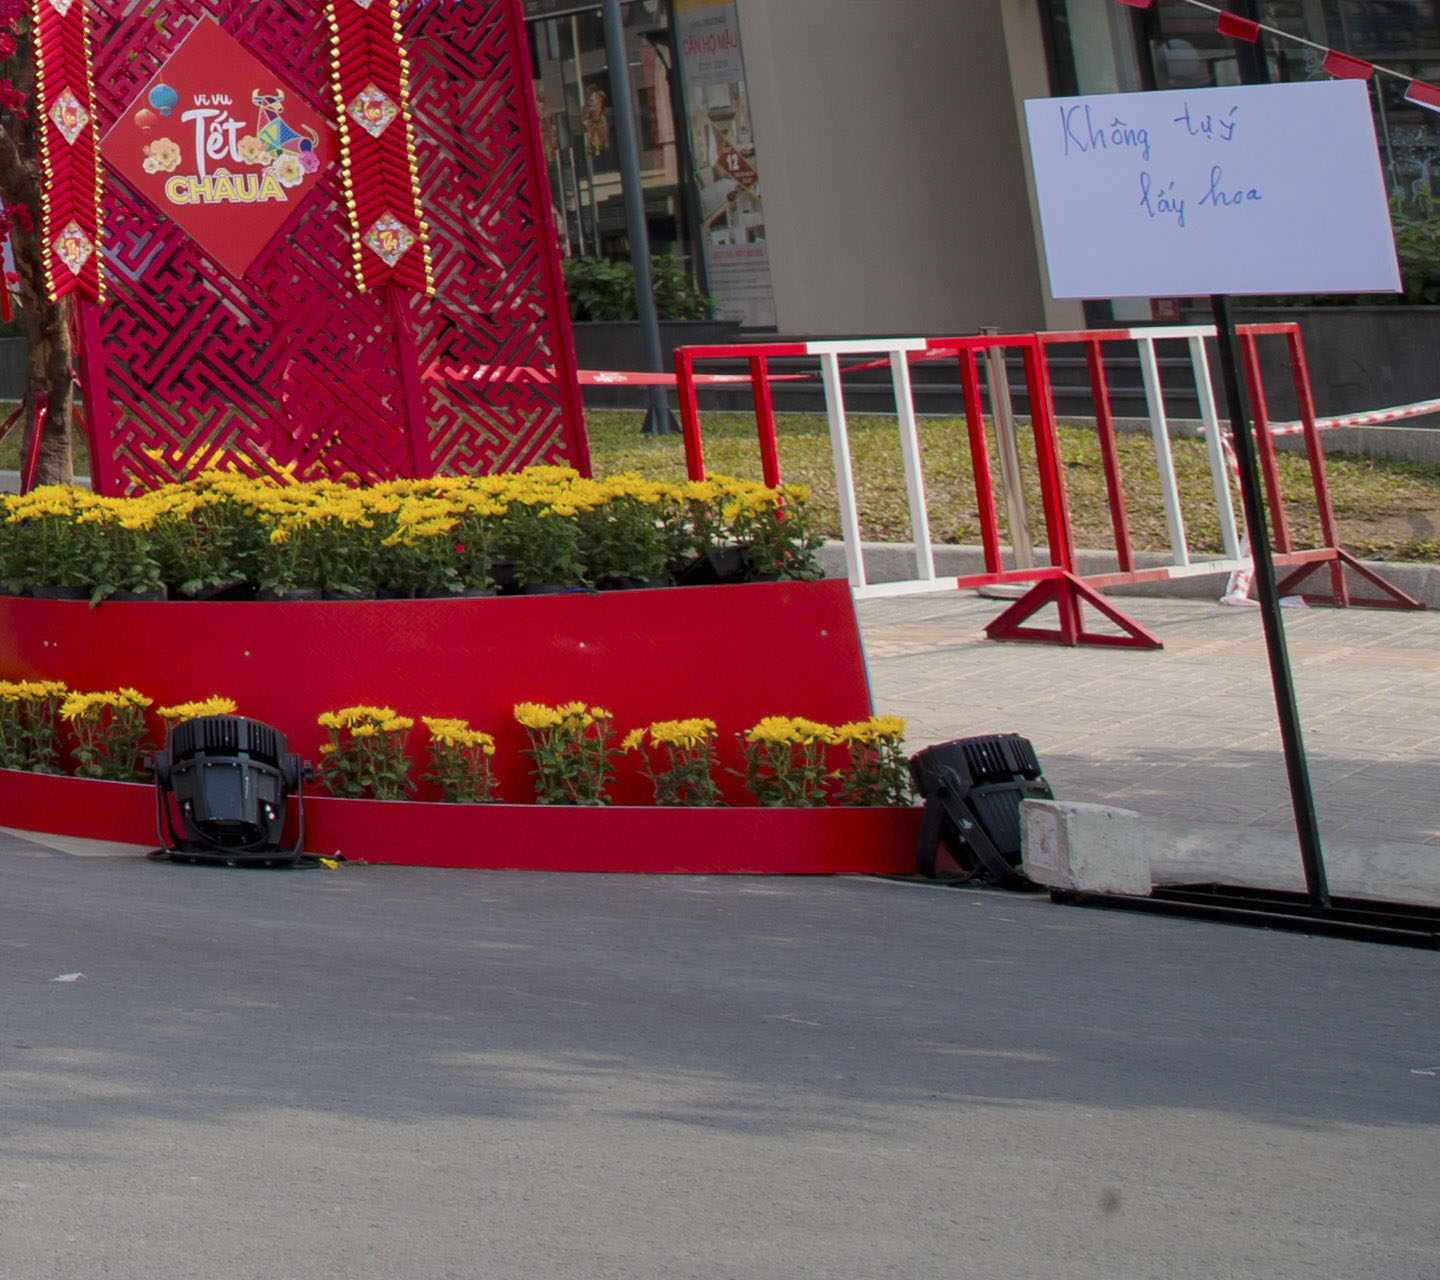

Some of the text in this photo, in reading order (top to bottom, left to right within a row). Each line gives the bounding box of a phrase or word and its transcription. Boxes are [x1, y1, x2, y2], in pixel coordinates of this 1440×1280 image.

[193, 93, 234, 107] vi vu
[181, 108, 248, 178] Tết
[1060, 104, 1150, 162] Không
[1139, 165, 1263, 228] lấy hoa
